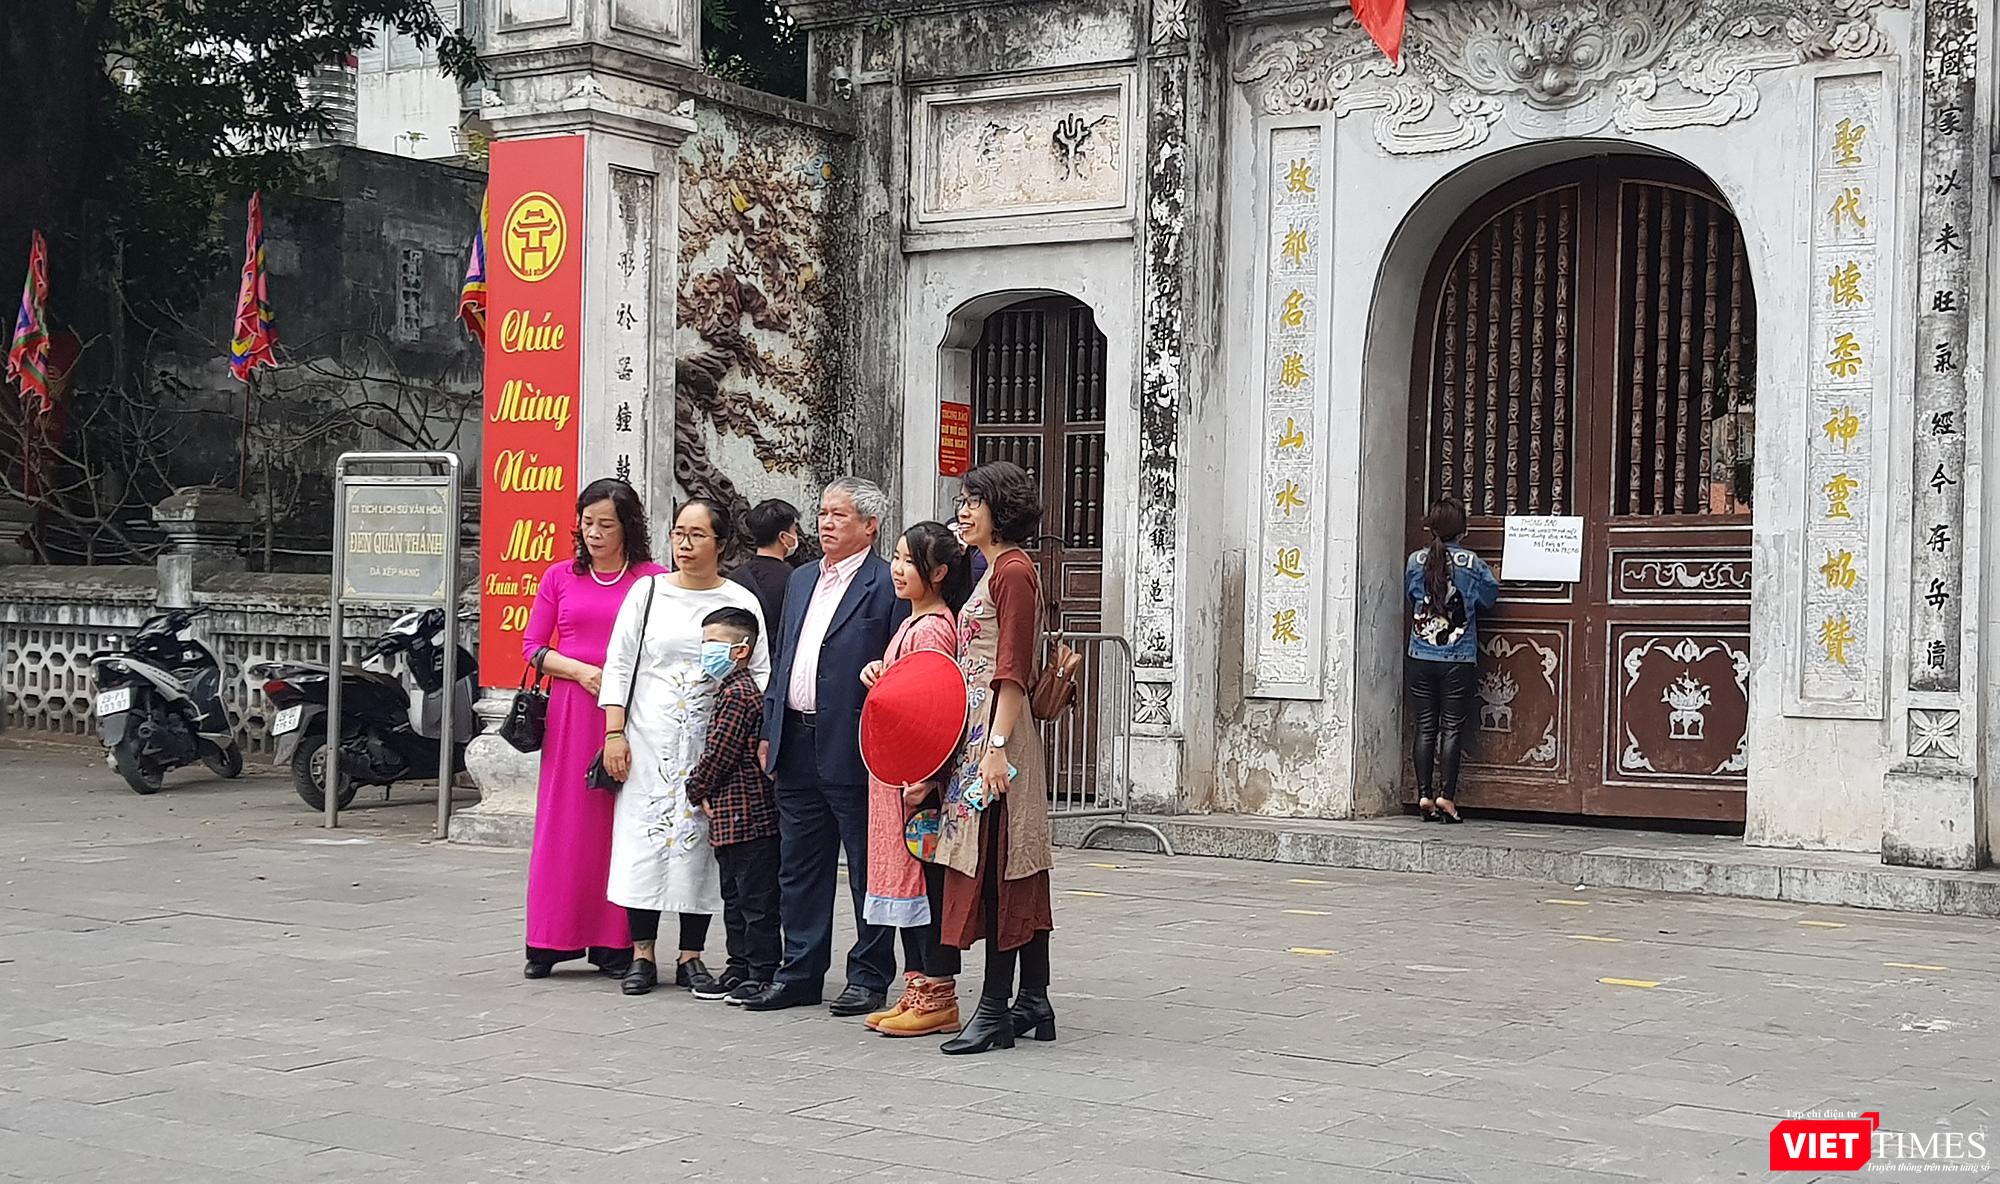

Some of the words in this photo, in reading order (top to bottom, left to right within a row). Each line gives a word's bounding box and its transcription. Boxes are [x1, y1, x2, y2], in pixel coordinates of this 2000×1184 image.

[501, 309, 566, 353] Chúc
[490, 379, 572, 431] Mừng
[494, 449, 566, 493] Năm
[501, 519, 556, 562] Mới
[1416, 551, 1474, 569] GCI
[485, 573, 519, 596] Xuân
[521, 573, 540, 597] Tâ
[499, 605, 534, 632] 20
